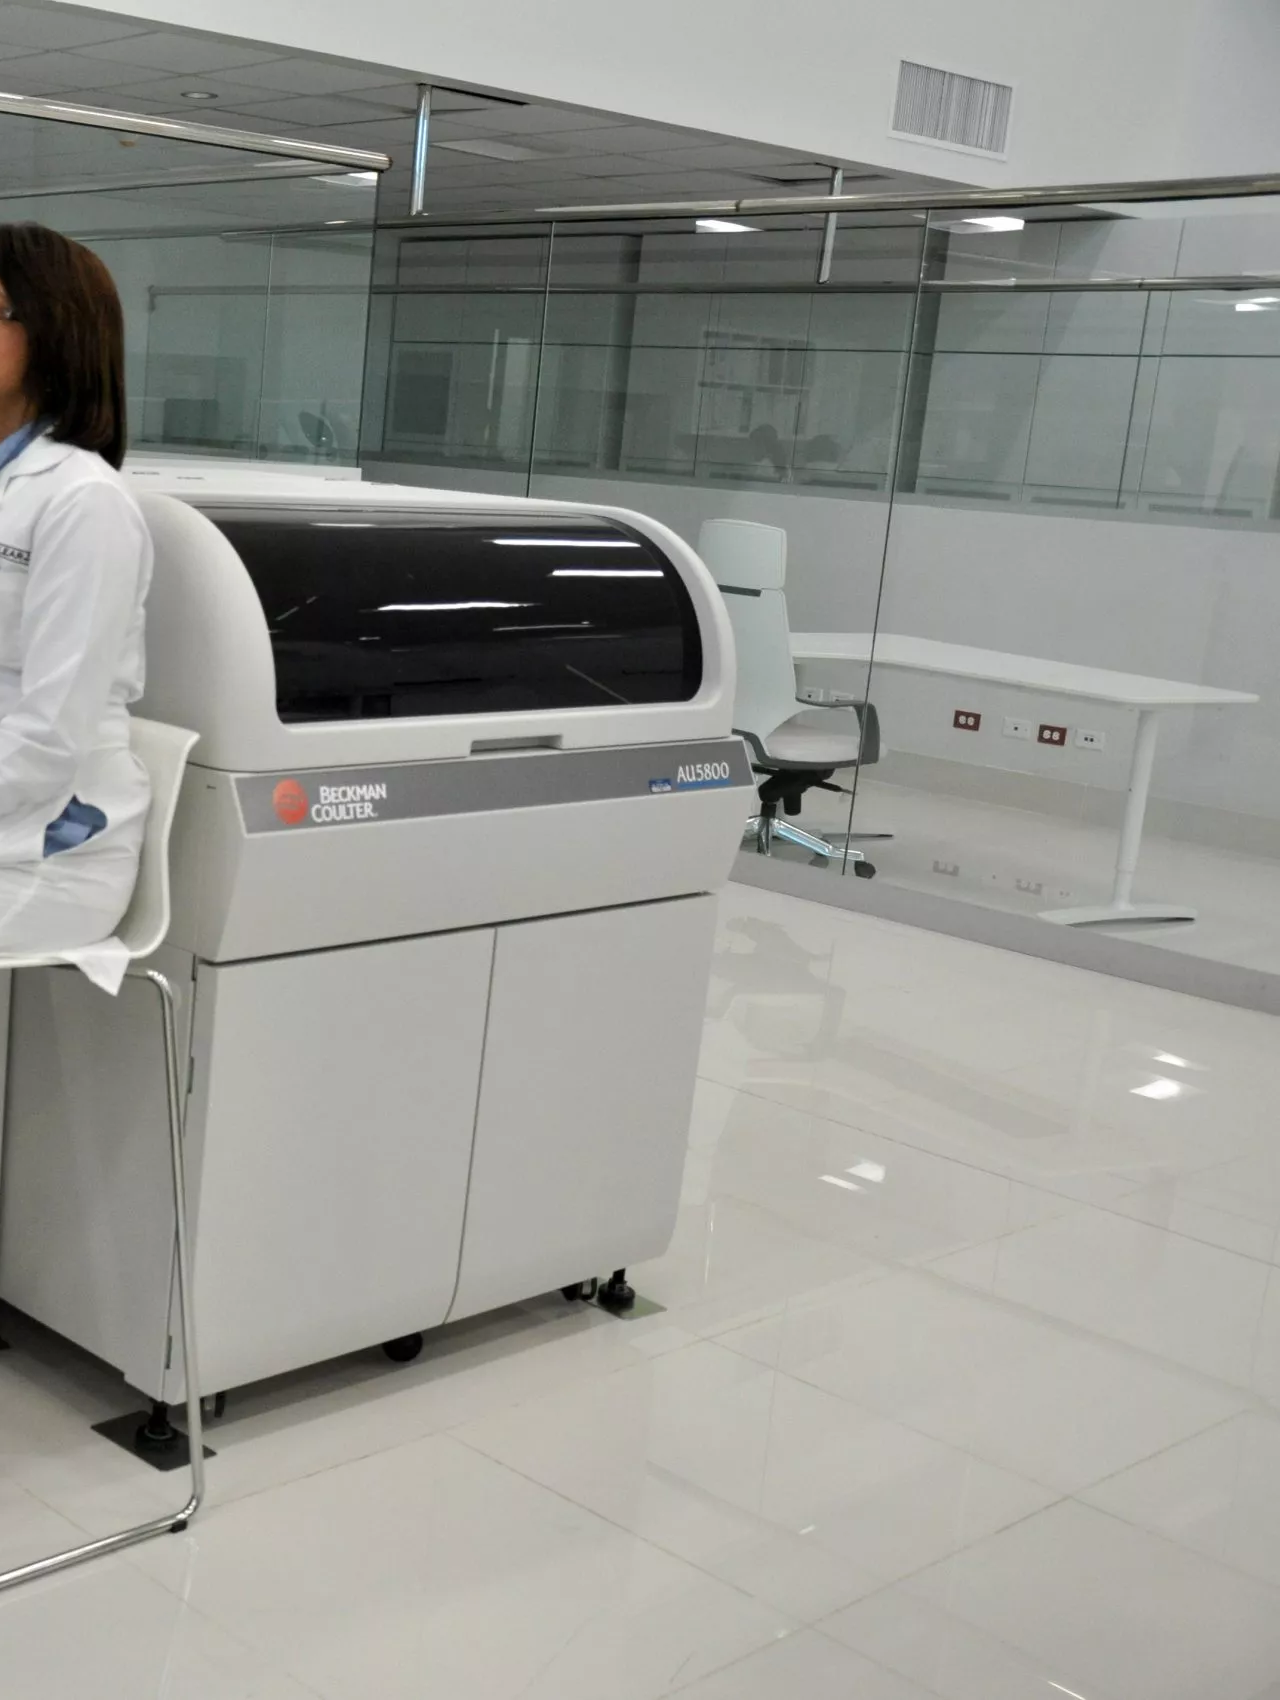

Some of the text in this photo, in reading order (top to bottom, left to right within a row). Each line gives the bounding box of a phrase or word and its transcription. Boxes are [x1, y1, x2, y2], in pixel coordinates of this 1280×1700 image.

[677, 761, 730, 783] AU5800
[320, 783, 387, 804] BECKMAN
[311, 801, 376, 823] COULTER
